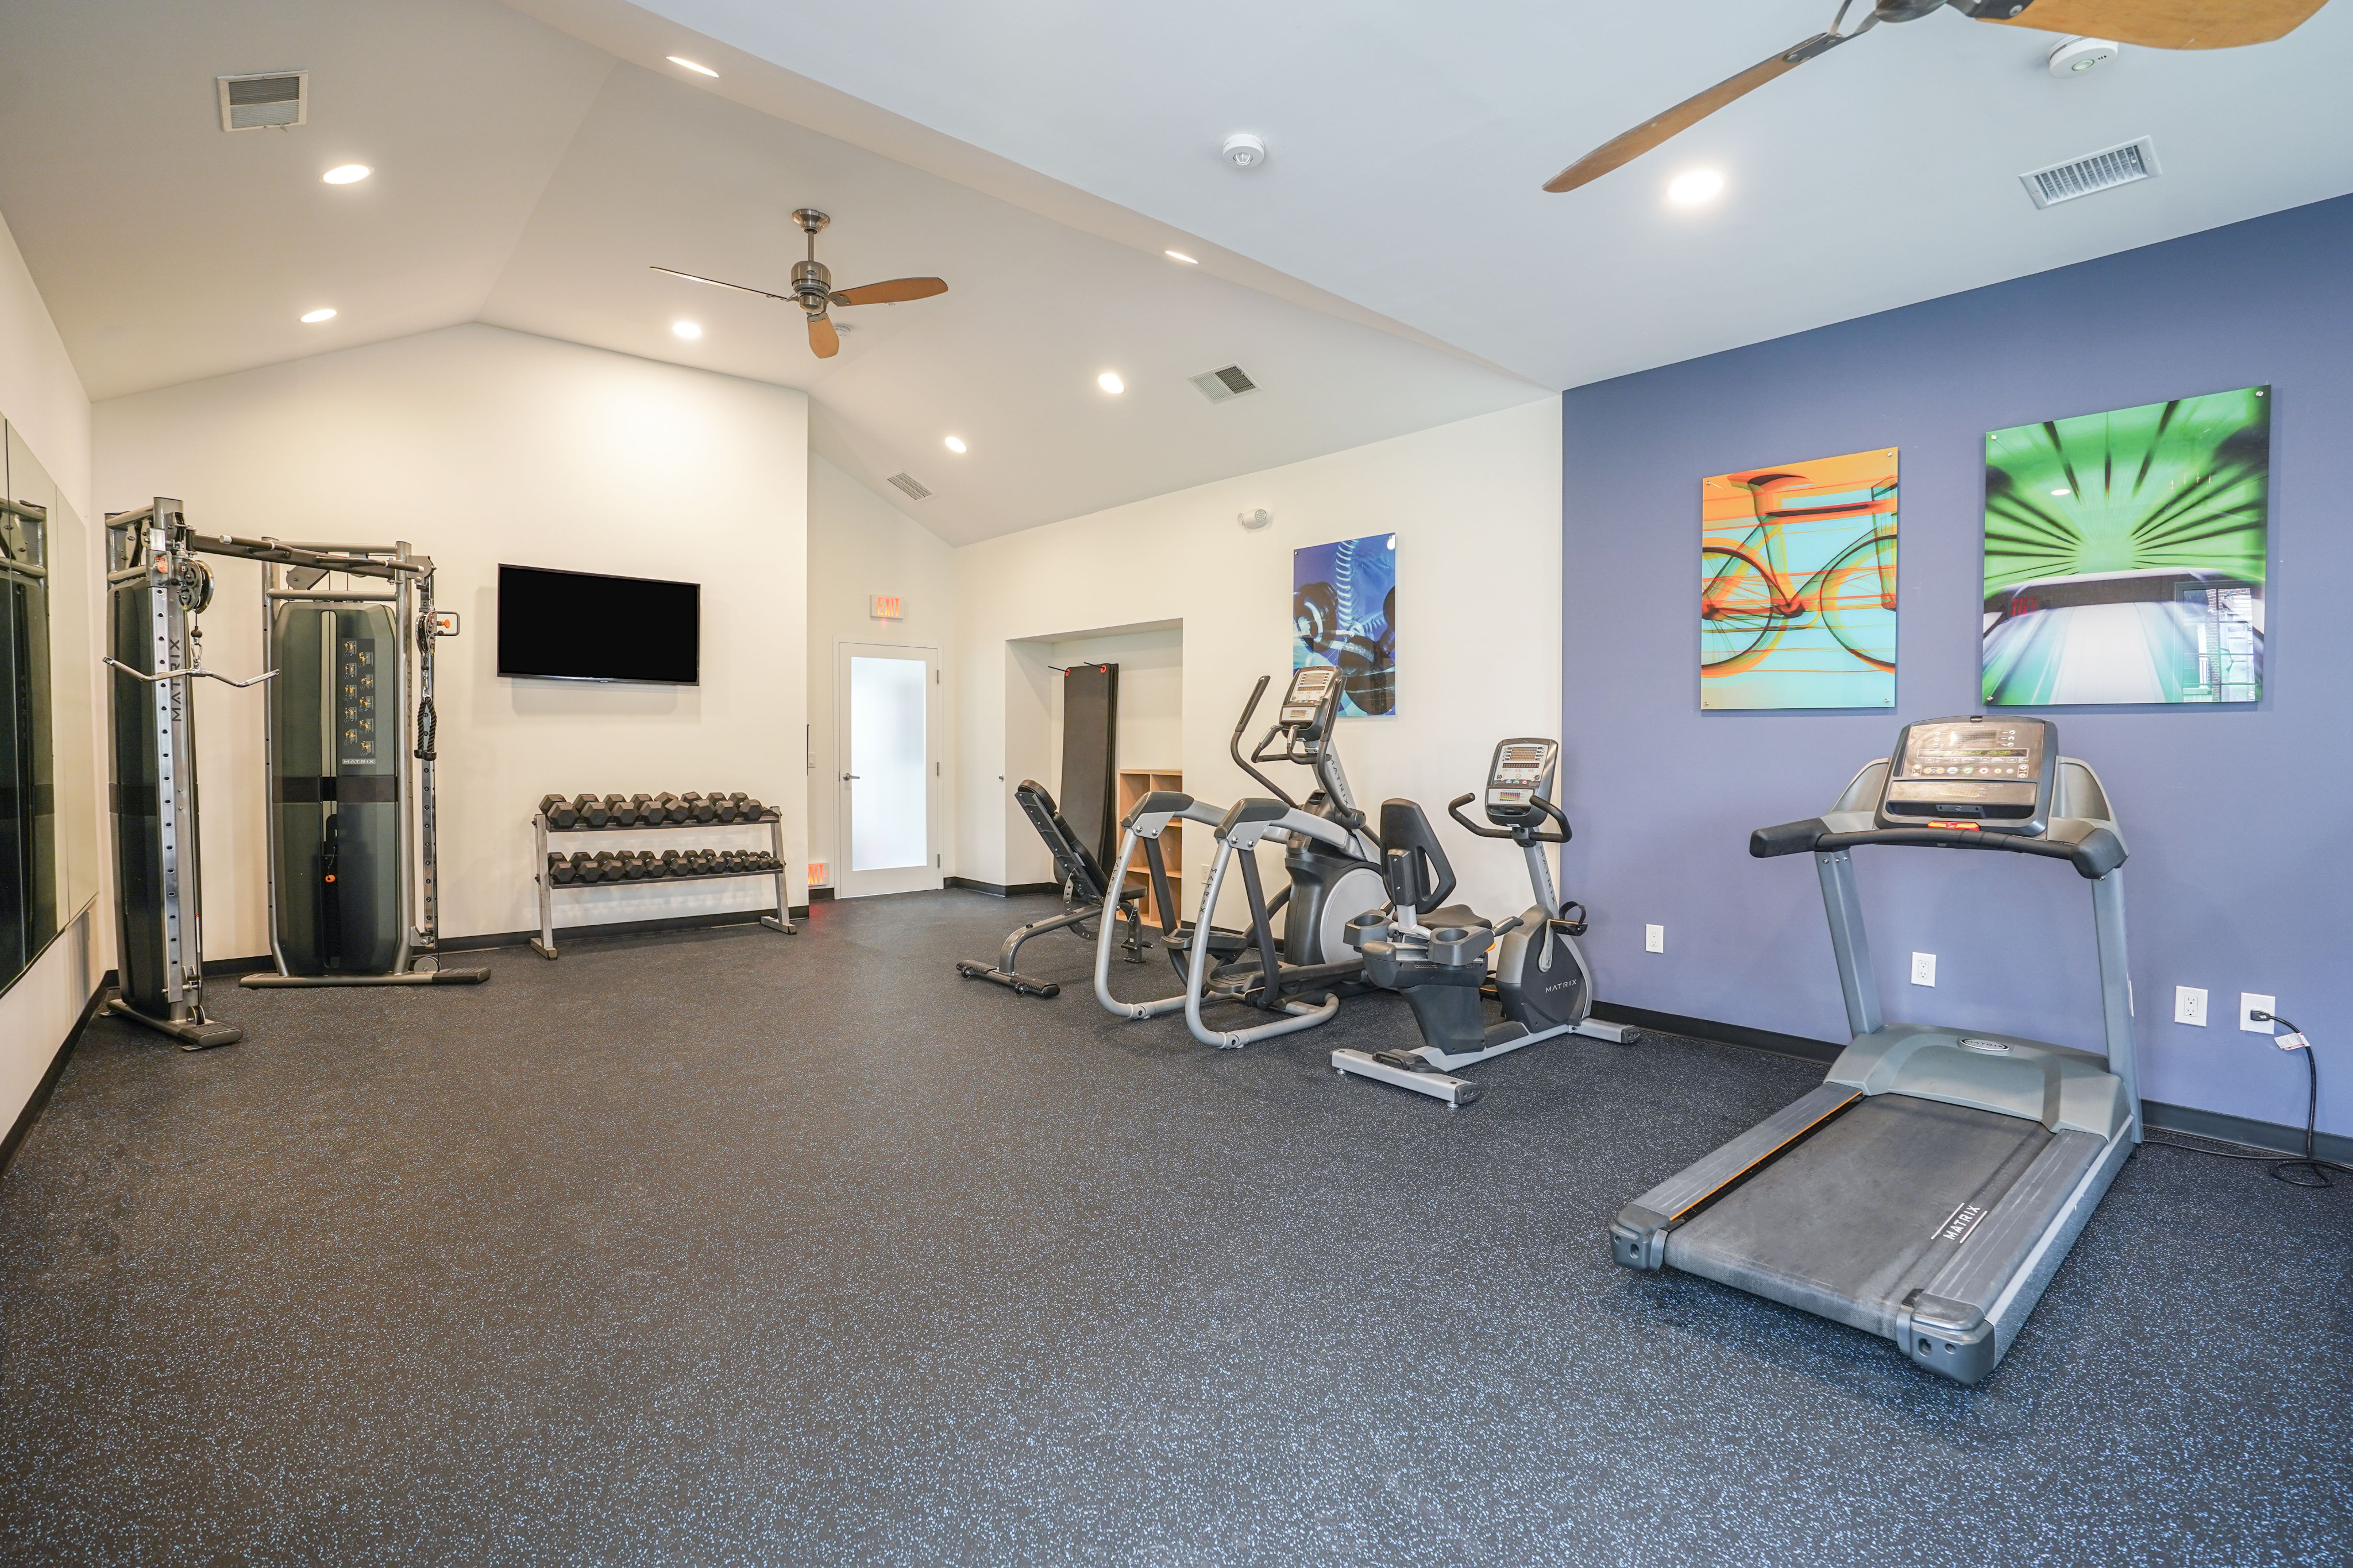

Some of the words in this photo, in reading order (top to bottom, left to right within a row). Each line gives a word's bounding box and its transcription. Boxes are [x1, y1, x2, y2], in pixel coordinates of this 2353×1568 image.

[877, 596, 901, 616] EXIT
[169, 639, 182, 721] MATRIX
[1331, 755, 1349, 806] MATRIX
[808, 864, 824, 884] XIT
[1107, 856, 1122, 896] MATRIX
[1199, 868, 1217, 913] MATRIX
[1540, 845, 1555, 905] MATRIX
[1545, 979, 1577, 993] MATRIX
[1966, 1040, 2003, 1048] MATRIX
[1942, 1205, 1981, 1240] MATRIX
